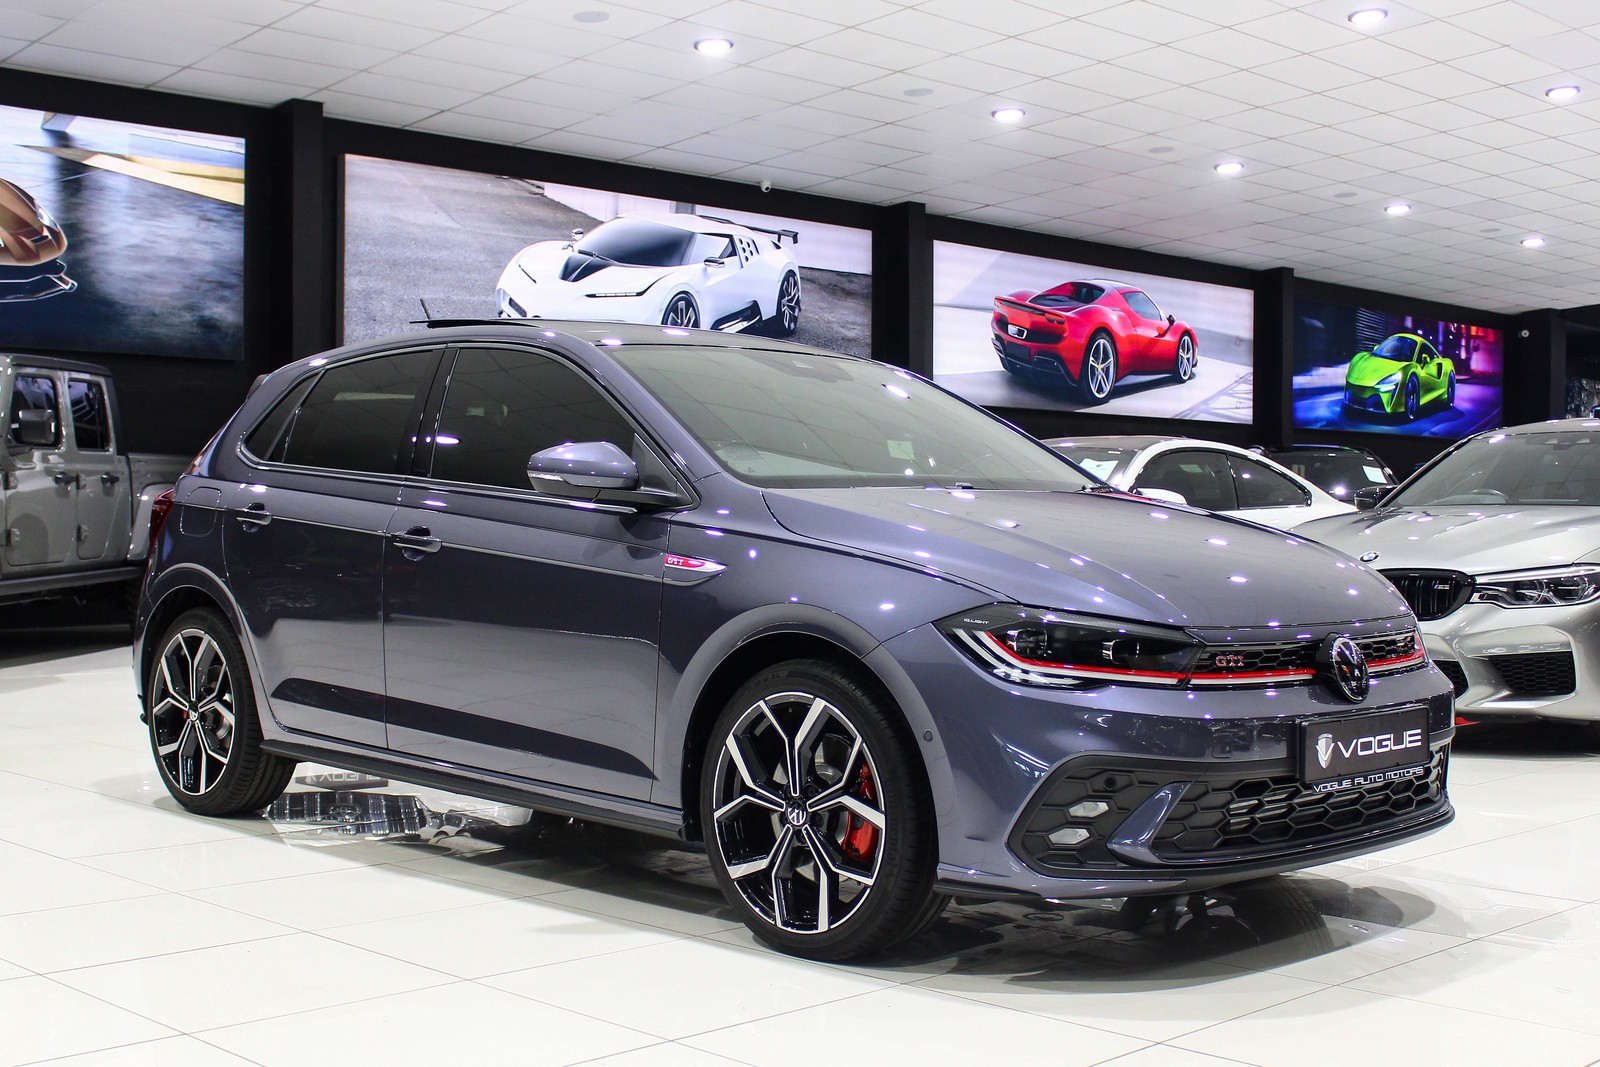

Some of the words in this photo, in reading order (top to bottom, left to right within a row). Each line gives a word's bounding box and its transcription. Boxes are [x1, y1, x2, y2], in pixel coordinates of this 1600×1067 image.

[667, 556, 684, 566] GTI
[1215, 655, 1244, 667] GTI
[1337, 728, 1422, 759] VOGUE
[1313, 779, 1352, 793] VOGUE
[1354, 773, 1384, 786] AUTO
[1386, 766, 1424, 780] MOTORS
